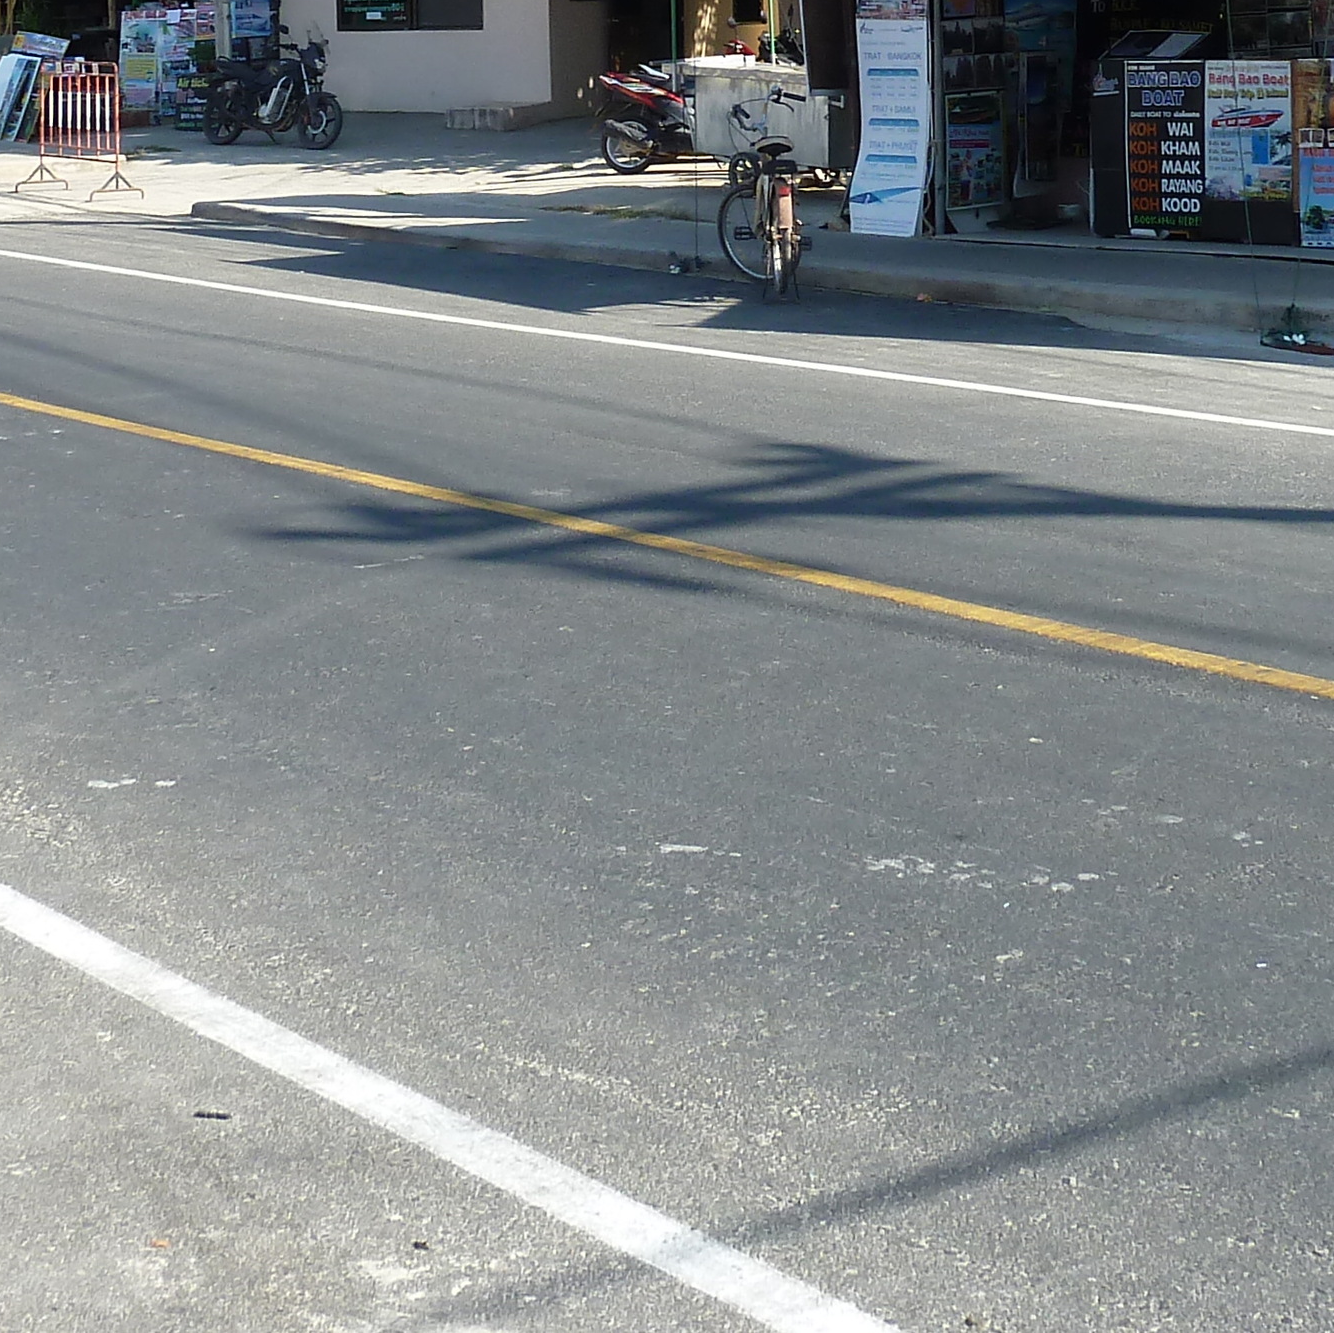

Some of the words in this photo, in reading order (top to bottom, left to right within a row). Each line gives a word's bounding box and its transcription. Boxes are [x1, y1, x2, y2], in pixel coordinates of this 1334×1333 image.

[863, 51, 882, 60] TRAT
[887, 51, 923, 61] BANGKOK
[1128, 71, 1168, 88] BANG
[1169, 71, 1201, 88] BAO
[1209, 73, 1235, 87] Bang
[1238, 73, 1260, 84] Bao
[1263, 73, 1289, 85] Boat
[1142, 89, 1184, 106] BOAT
[1130, 123, 1157, 136] KOH
[1167, 122, 1194, 136] WAI
[1130, 141, 1158, 155] KOH
[1161, 141, 1200, 155] KHAM
[1130, 160, 1158, 174] KOH
[1161, 160, 1200, 175] MAAK
[1131, 178, 1158, 192] KOH
[1161, 178, 1203, 194] RAYANG
[1132, 197, 1159, 211] KOH
[1162, 197, 1200, 213] KOOD
[1133, 215, 1175, 226] BOOKING
